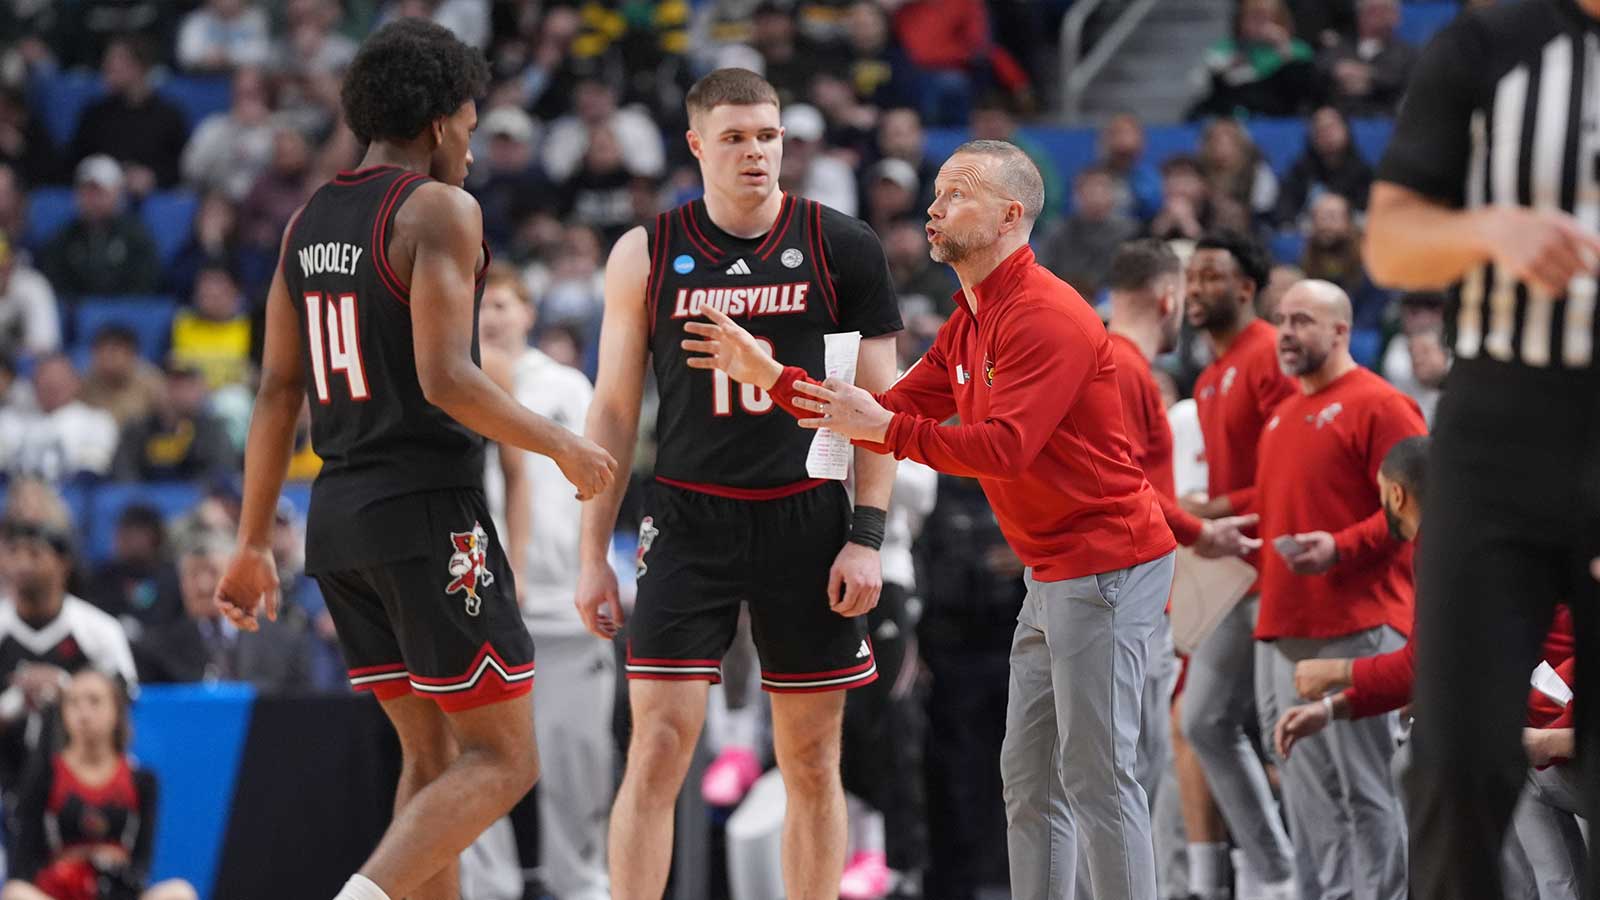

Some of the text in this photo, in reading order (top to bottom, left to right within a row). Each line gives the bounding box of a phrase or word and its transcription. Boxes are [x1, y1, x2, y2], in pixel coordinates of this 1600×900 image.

[299, 242, 363, 278] WOOLEY
[671, 282, 810, 319] LOUISVILLE
[303, 291, 371, 404] 14
